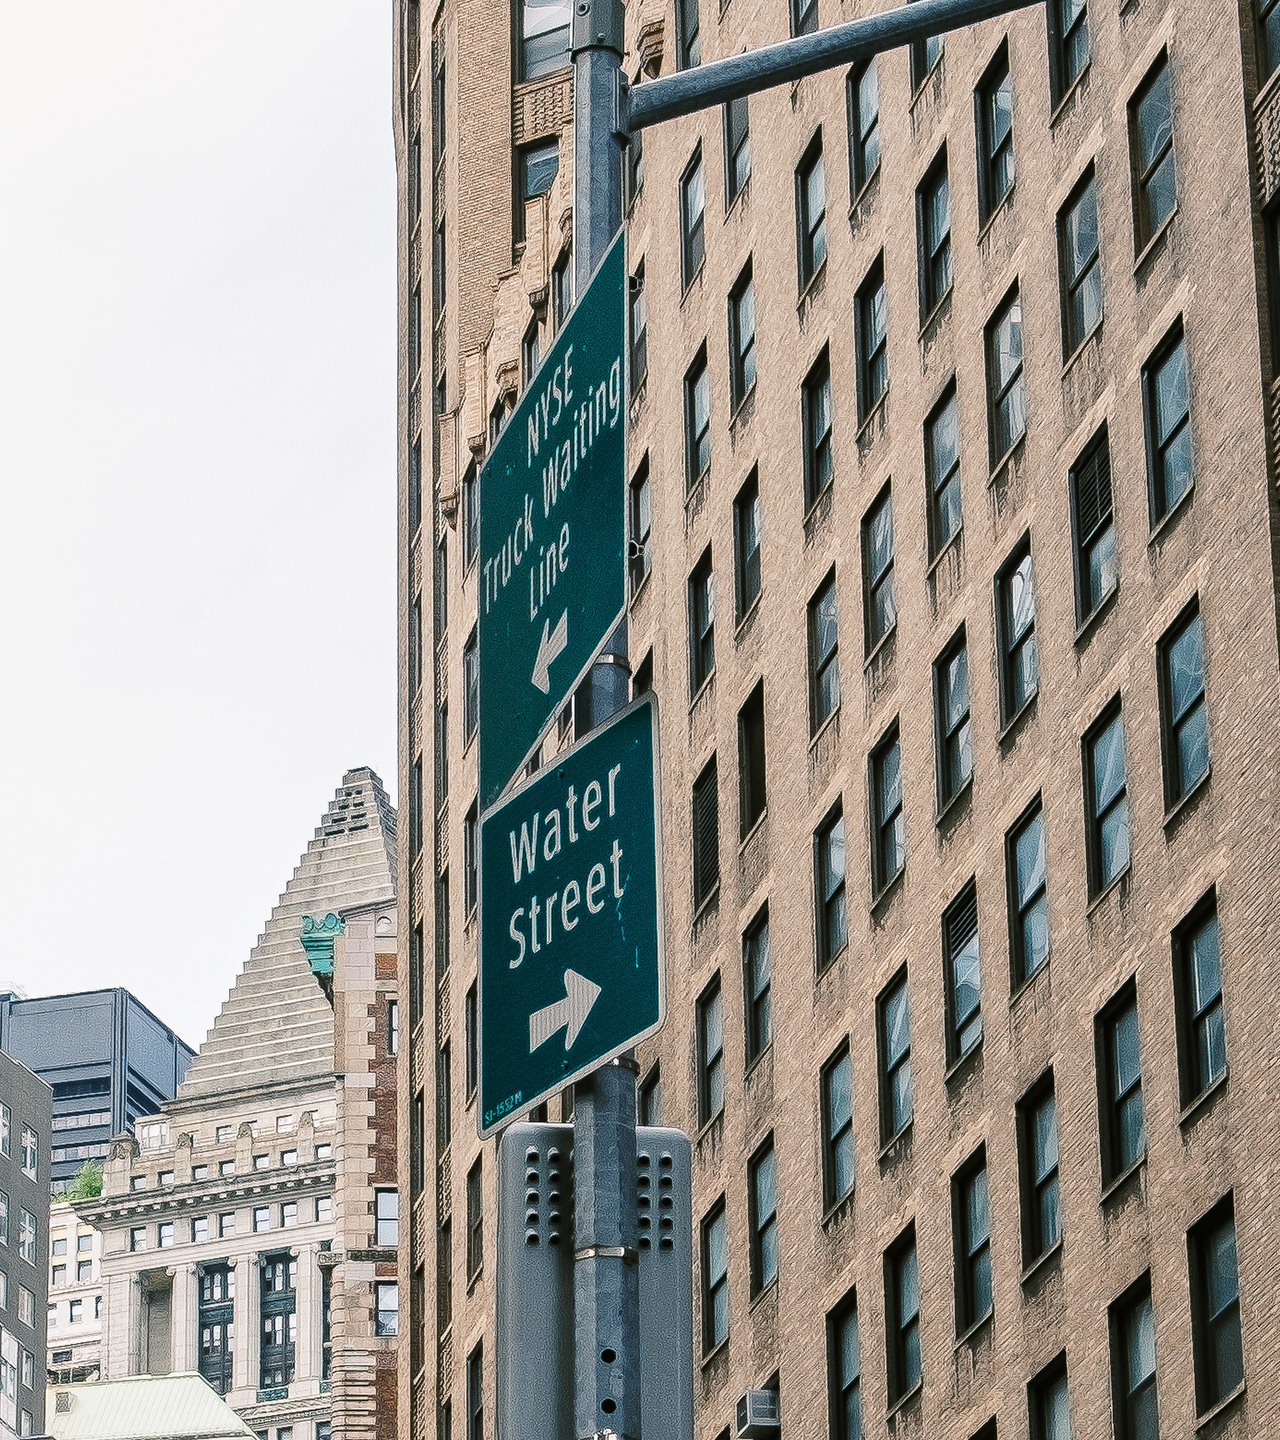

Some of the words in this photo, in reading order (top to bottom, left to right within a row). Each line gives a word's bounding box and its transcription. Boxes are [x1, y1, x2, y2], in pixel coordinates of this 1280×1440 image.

[527, 343, 573, 468] NYSE
[484, 493, 534, 614] Truck
[542, 355, 620, 519] Waiting
[530, 522, 569, 622] Line
[509, 763, 621, 884] Water
[509, 838, 624, 969] Street
